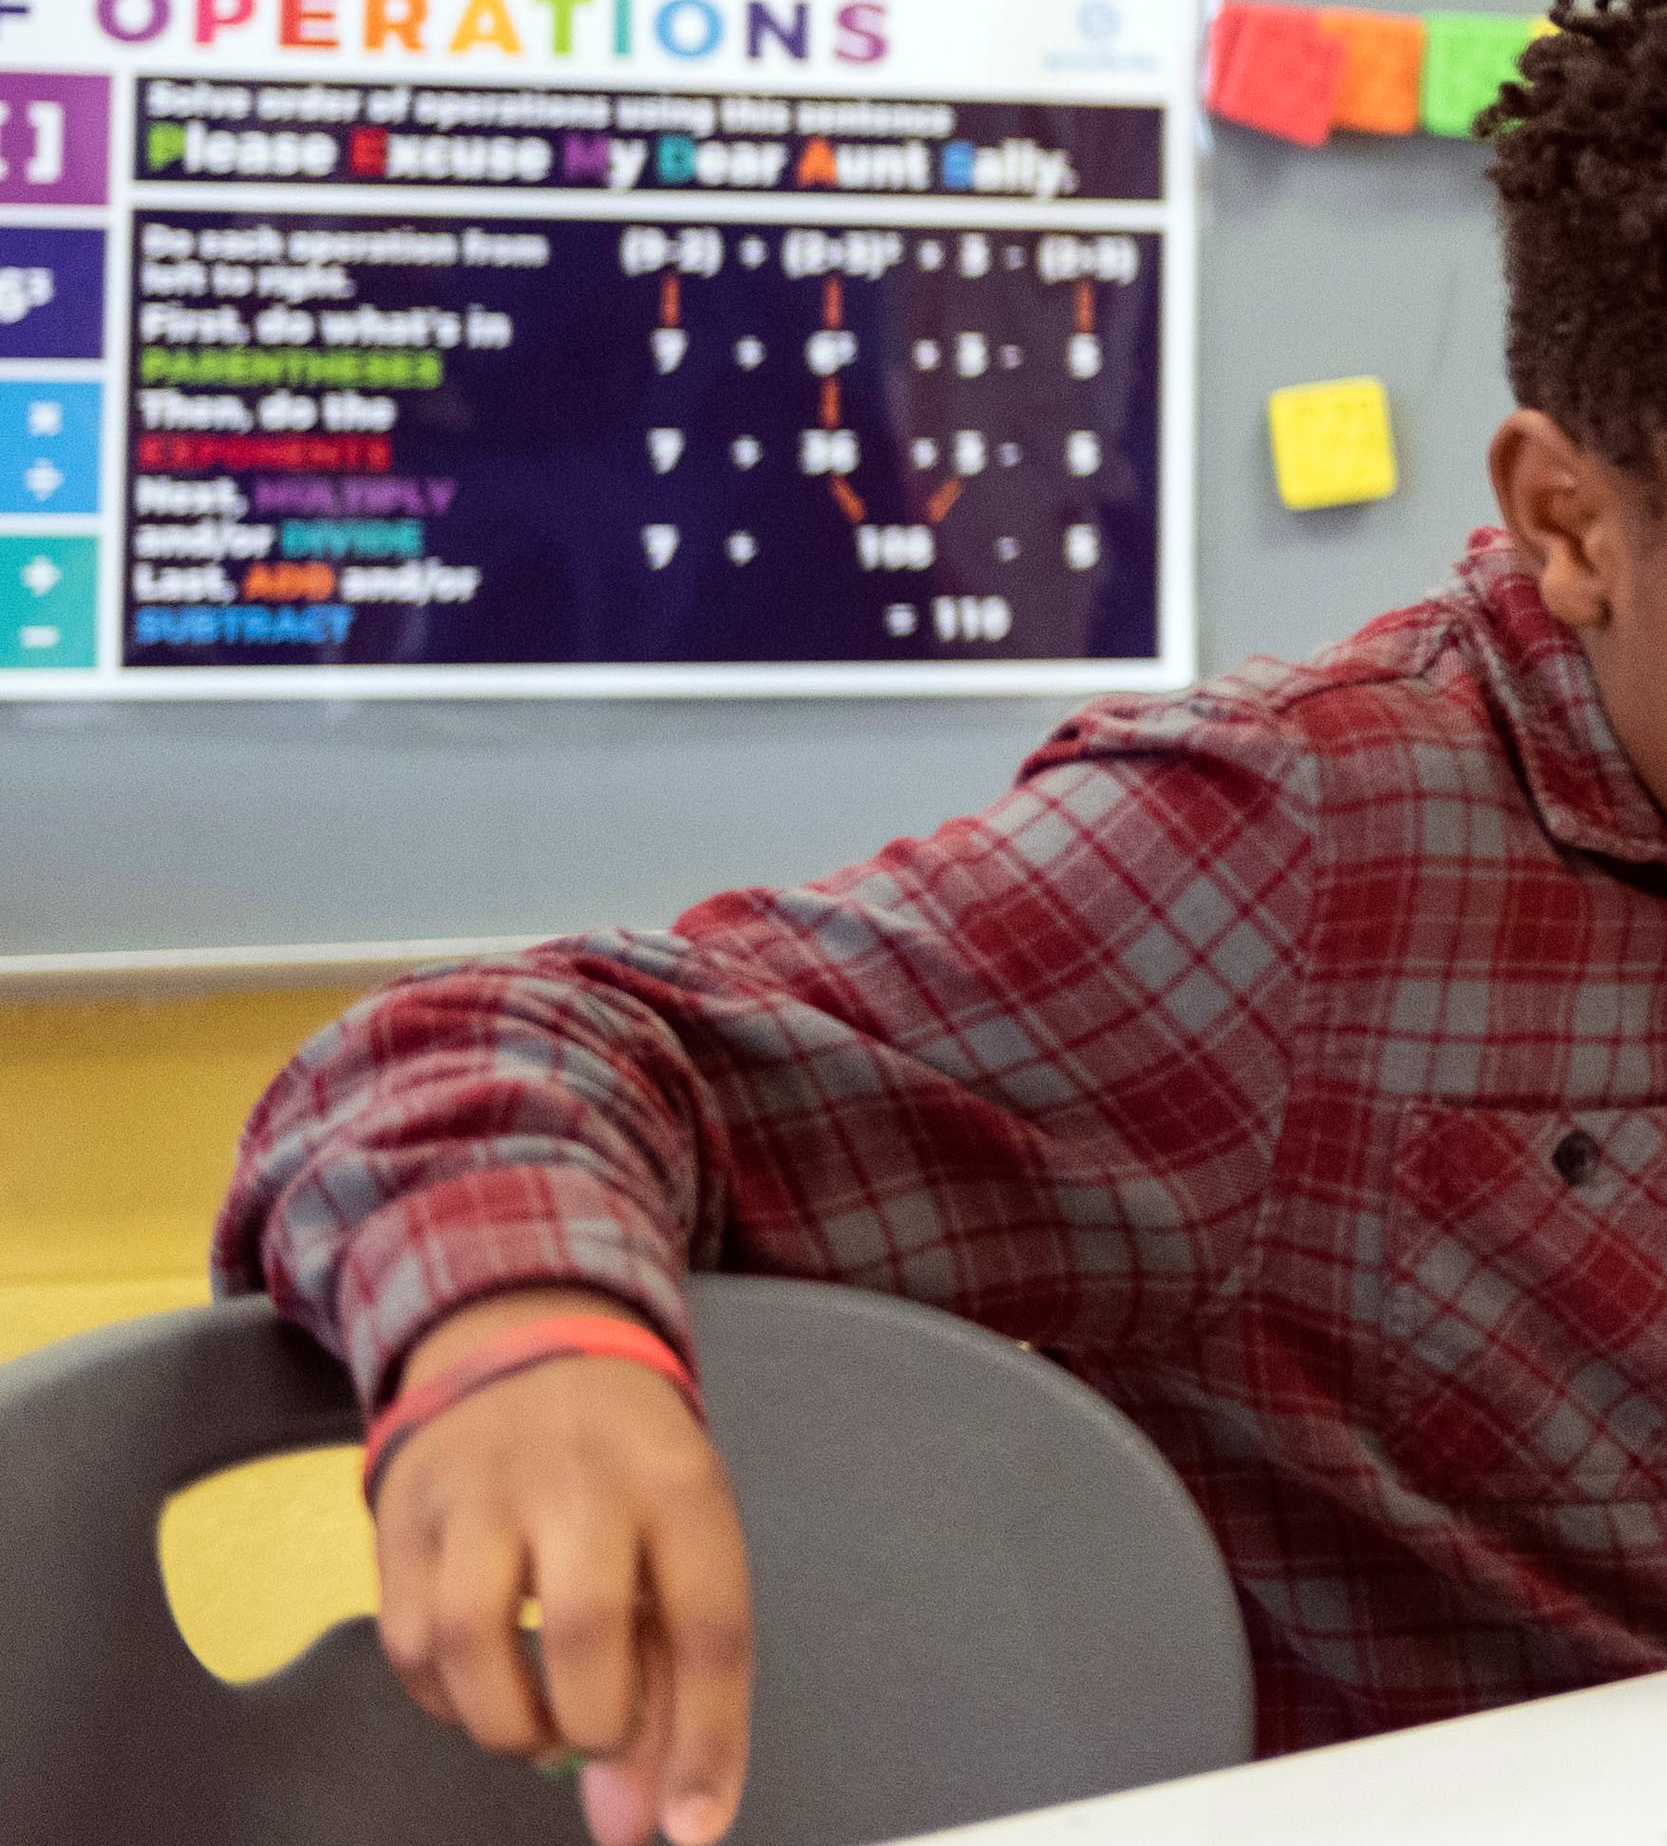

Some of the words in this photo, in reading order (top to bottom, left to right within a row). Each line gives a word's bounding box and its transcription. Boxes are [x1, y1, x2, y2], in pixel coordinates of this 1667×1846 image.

[149, 120, 337, 174] Please
[797, 135, 929, 190] Aunt
[256, 307, 314, 345] do
[259, 391, 317, 430] do
[323, 392, 396, 431] the
